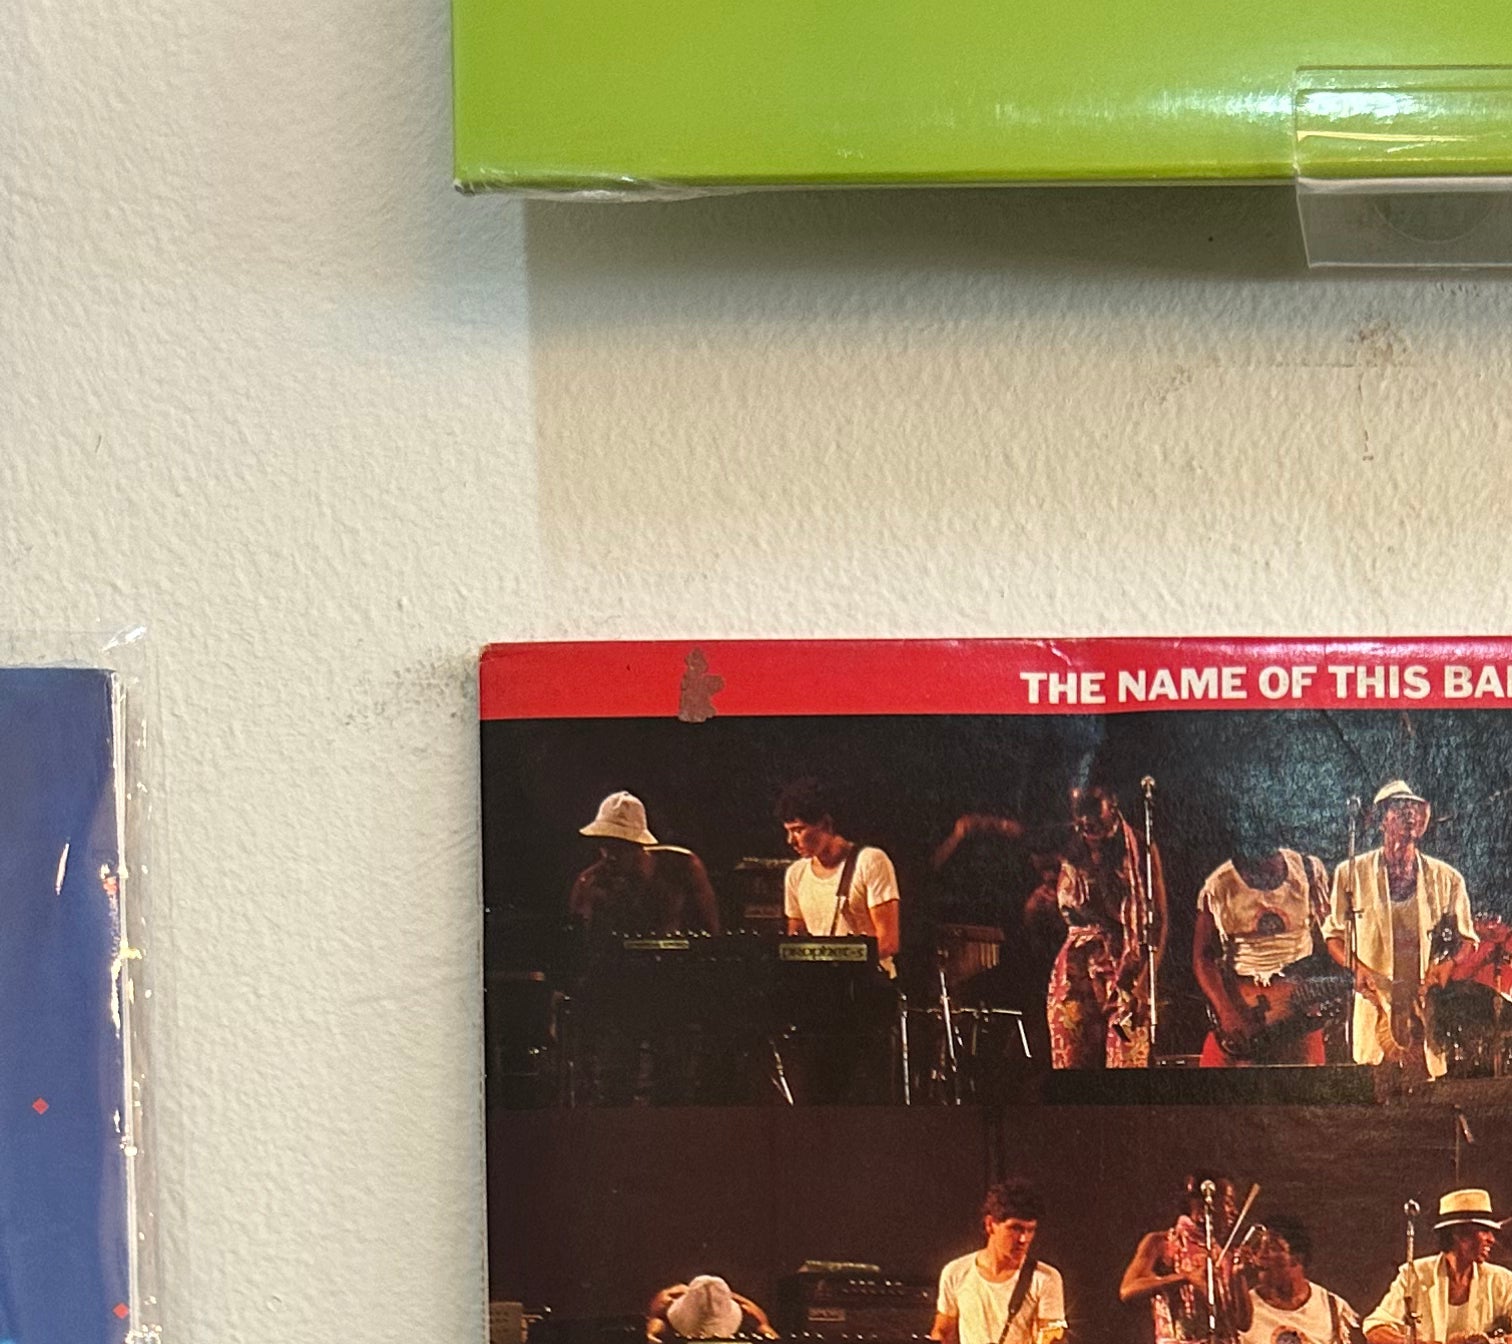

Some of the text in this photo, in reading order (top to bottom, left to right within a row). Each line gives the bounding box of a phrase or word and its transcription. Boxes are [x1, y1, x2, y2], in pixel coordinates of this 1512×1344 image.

[1019, 671, 1107, 705] THE
[1118, 667, 1248, 703] NAME
[1258, 666, 1317, 700] OF
[1327, 664, 1432, 700] THIS
